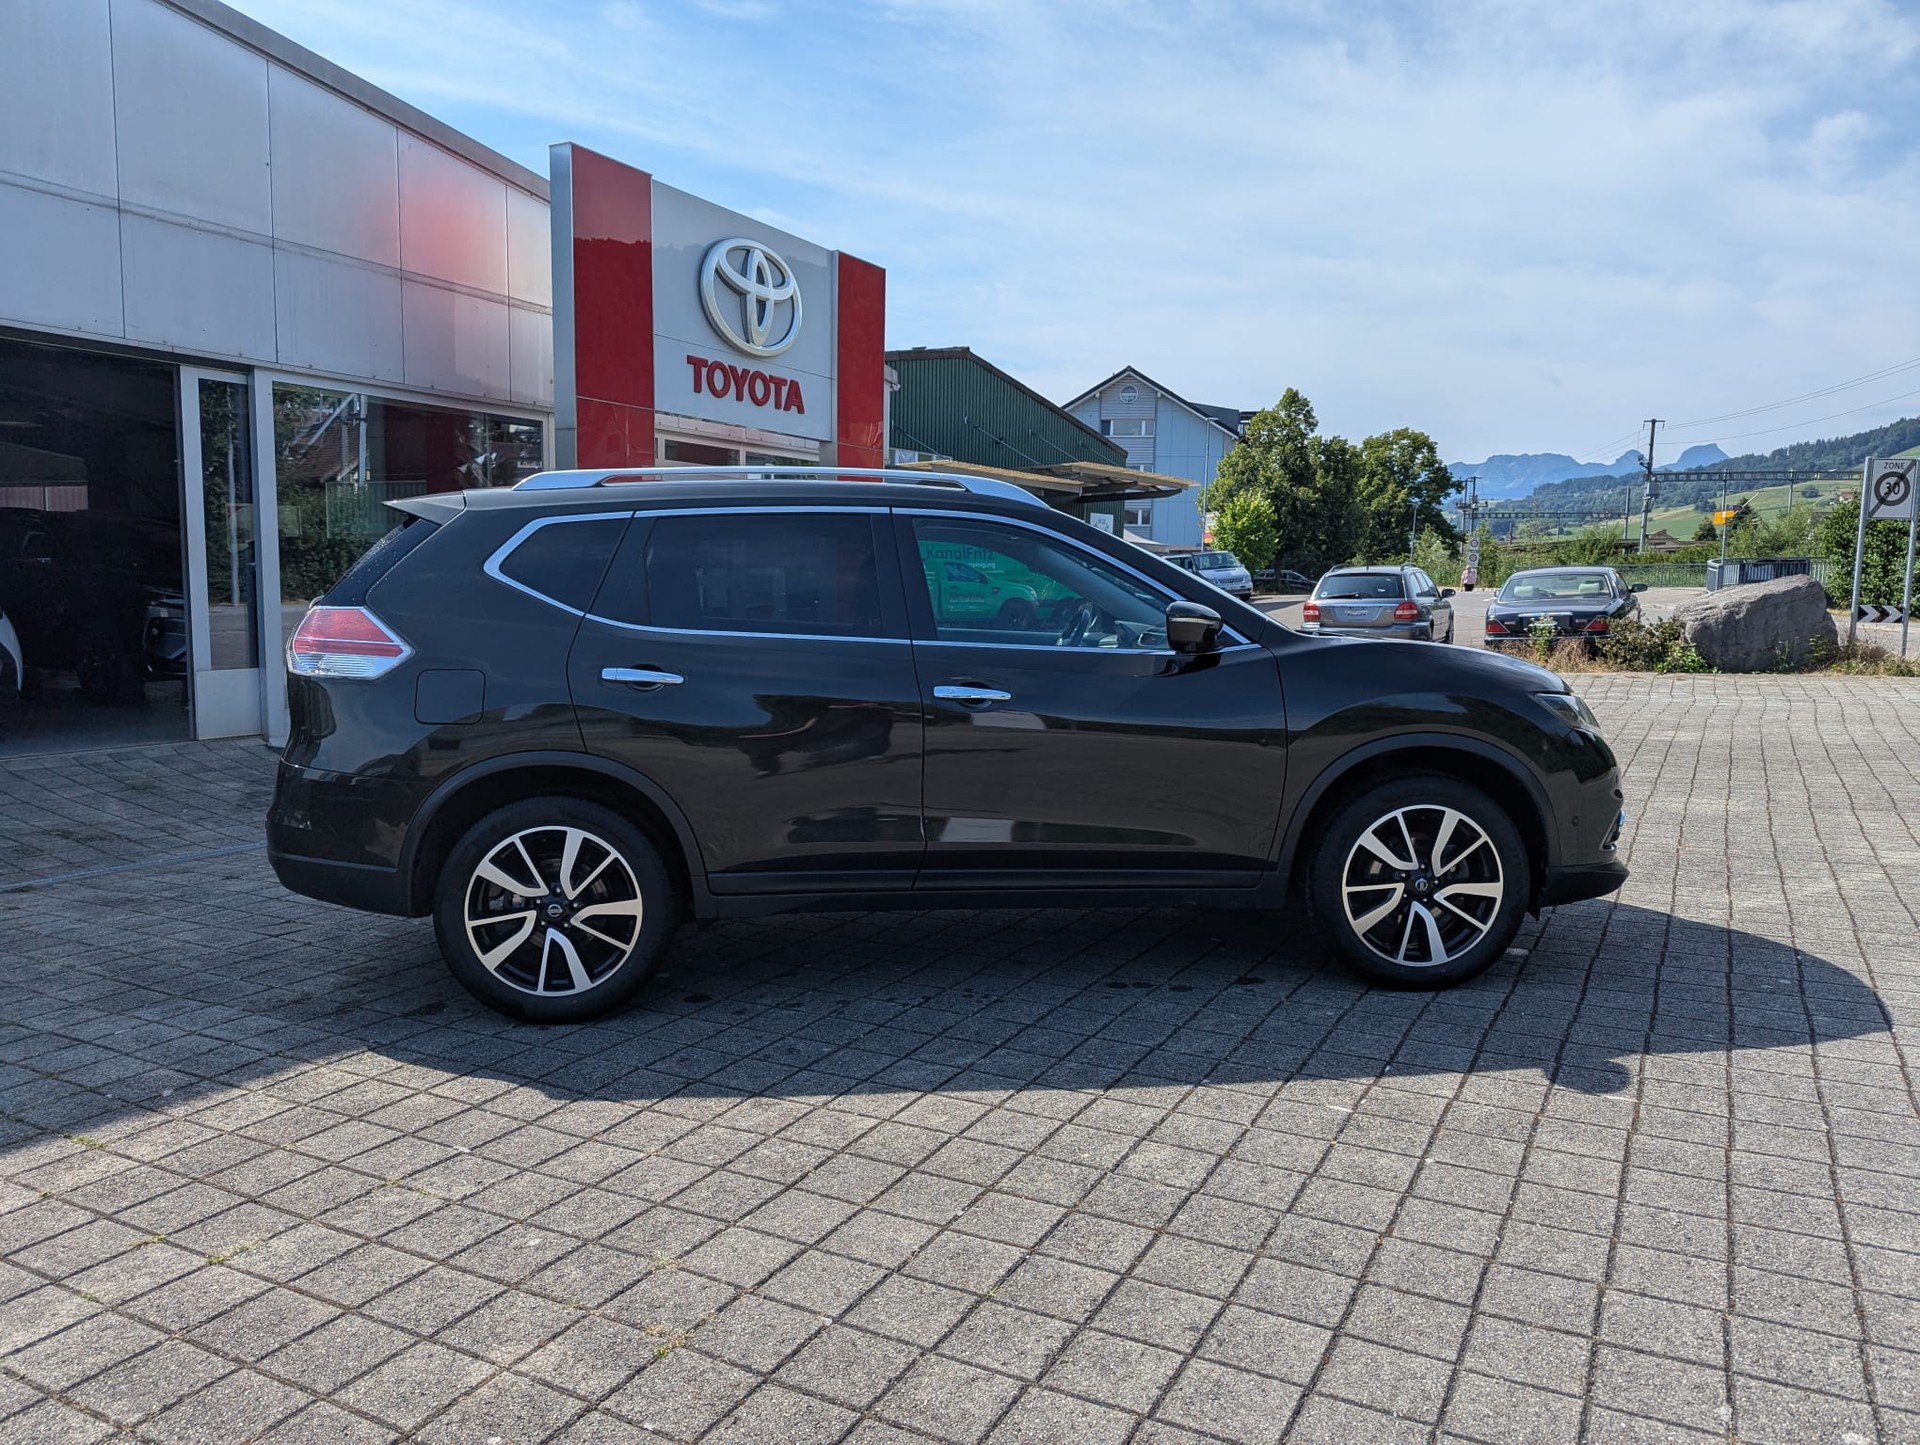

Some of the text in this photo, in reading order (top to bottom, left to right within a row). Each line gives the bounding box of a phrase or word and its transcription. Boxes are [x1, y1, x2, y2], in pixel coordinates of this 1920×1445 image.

[686, 354, 805, 415] TOYOTA
[1883, 462, 1905, 470] ZONE
[1884, 482, 1900, 496] 30
[926, 546, 995, 560] KanalFritz
